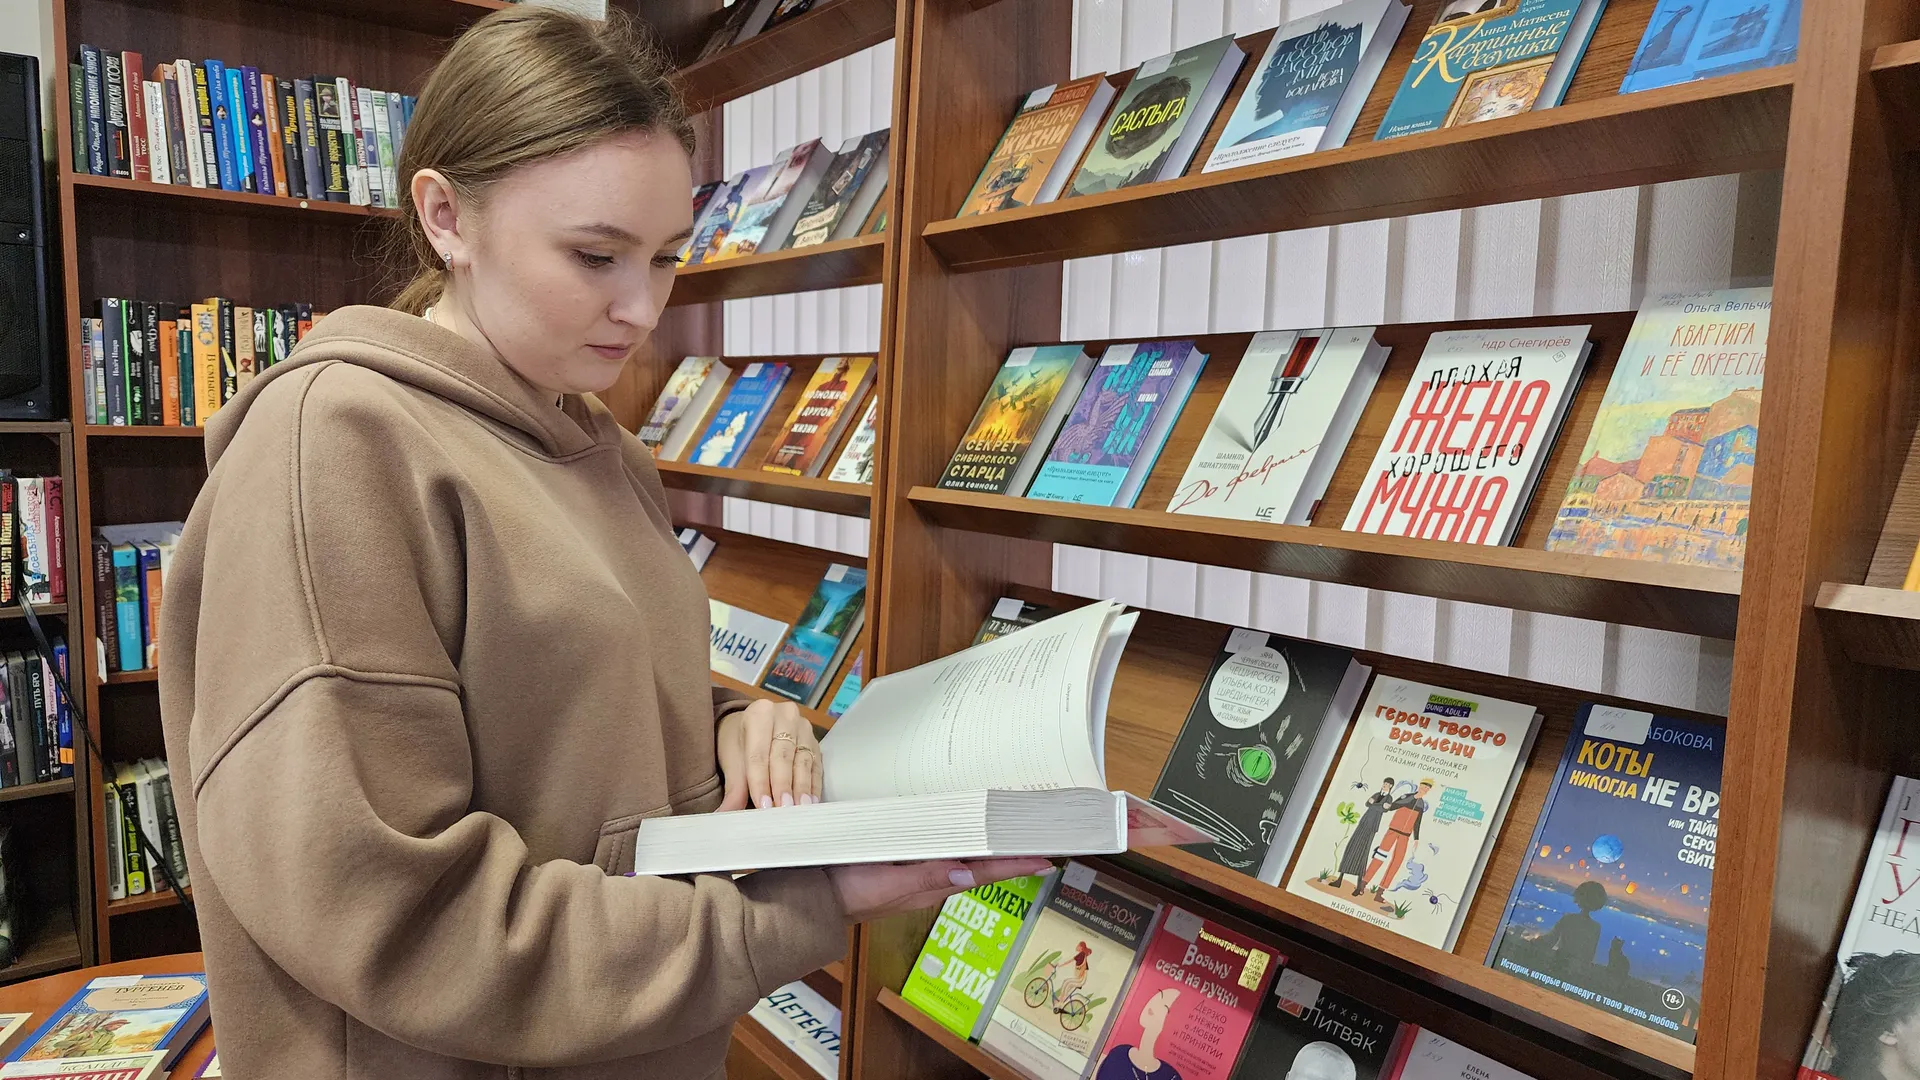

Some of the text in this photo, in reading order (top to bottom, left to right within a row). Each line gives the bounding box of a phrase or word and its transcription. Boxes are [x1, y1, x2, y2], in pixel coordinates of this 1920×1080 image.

[1473, 9, 1571, 40] Анна Матвеева
[84, 51, 98, 75] ЛУНОЙ
[1411, 18, 1568, 89] Картинные
[1462, 36, 1557, 71] девушки
[1008, 103, 1076, 137] БАХРОМА
[1110, 96, 1187, 137] САСПЫГА
[997, 125, 1067, 158] ЖИЗНИ
[1684, 302, 1721, 315] Ольга
[1508, 336, 1572, 349] Снегирёв
[1670, 322, 1756, 348] КВАРТИРА
[1429, 356, 1523, 391] ПЛОХАЯ
[1641, 354, 1657, 378] И
[1660, 351, 1687, 378] ЕЁ
[206, 353, 216, 409] В смысле
[802, 406, 836, 417] ДРУГОЙ
[1390, 379, 1551, 458] ЖЕНА
[791, 423, 820, 434] ЖИЗНИ
[954, 452, 1018, 466] СИБИРСКОГО
[965, 439, 1021, 453] СЕКРЕТ
[1216, 452, 1245, 462] ШАМИЛЬ
[950, 465, 1006, 481] СТАРЦА
[1198, 461, 1242, 472] ИДИАТУЛЛИН
[1385, 443, 1524, 480] ХОРОШЕГО
[944, 480, 999, 492] ЮЛИЯ ЕФИМОВА
[1172, 443, 1322, 514] До февраля
[1356, 470, 1510, 546] МУЖА
[0, 512, 13, 546] ПОХОД
[988, 620, 1001, 631] 77
[1229, 666, 1280, 684] ЧЕШИРСКАЯ
[1241, 656, 1279, 670] ЧЕРНИГОВСКАЯ
[31, 672, 43, 709] ПУТЬ БРО
[1220, 676, 1277, 697] УЛЫБКА КОТА
[1374, 704, 1507, 747] Герои твоего
[1444, 706, 1468, 718] ADULT
[1383, 744, 1420, 759] ПОСТУПКИ
[1388, 726, 1476, 759] времени
[1384, 754, 1459, 780] ГЛАЗАМИ ПСИХОЛОГА
[1577, 739, 1655, 779] КОТЫ
[1568, 769, 1639, 799] НИКОГДА
[1640, 776, 1680, 808] НЕ
[1682, 834, 1717, 855] СЕРО
[1071, 905, 1085, 915] ЖИР
[1089, 913, 1137, 941] ФИТНЕС-ТРЕНДЫ
[1109, 903, 1142, 929] ЗОЖ
[1330, 900, 1391, 930] МАРИЯ ПРОНИНА
[929, 914, 973, 956] СТИ
[1182, 943, 1233, 979] Возьму
[115, 983, 186, 995] ТУРГЕНЕВ
[941, 955, 997, 1006] ЦИЙ
[1155, 959, 1239, 1009] себя на ручки
[1500, 957, 1680, 1032] Истории, которые приведут в твою жизнь любовь
[1665, 992, 1682, 1006] 18+
[1191, 1026, 1220, 1046] ЛЮБВИ
[1194, 1015, 1225, 1035] НЕЖНО
[1302, 1006, 1377, 1054] Литвак
[1178, 1031, 1224, 1060] ПРИНЯТИИ
[1466, 1063, 1491, 1080] ЕЛЕНА
